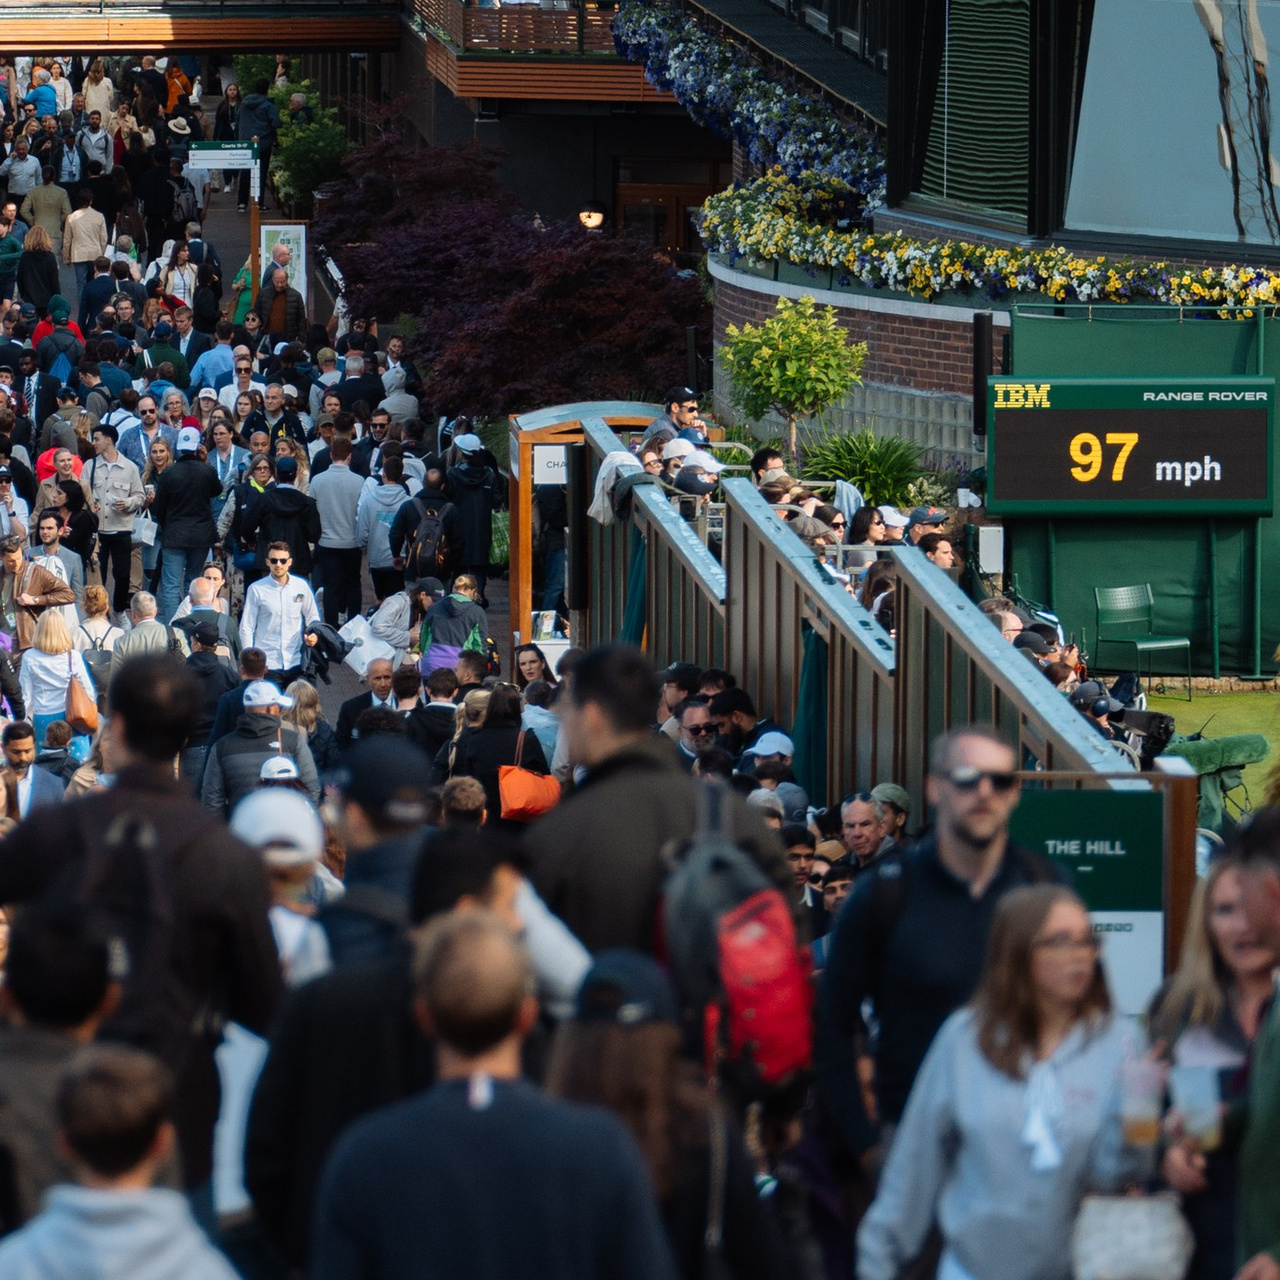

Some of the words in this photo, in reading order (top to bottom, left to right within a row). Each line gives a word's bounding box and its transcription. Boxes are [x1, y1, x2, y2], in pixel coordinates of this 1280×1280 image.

[993, 384, 1051, 408] IBM
[1143, 392, 1204, 401] RANGE
[1208, 392, 1268, 401] ROVER
[1069, 432, 1139, 482] 97
[1155, 455, 1222, 487] mph
[1045, 840, 1082, 855] THE
[1086, 840, 1126, 855] HILL
